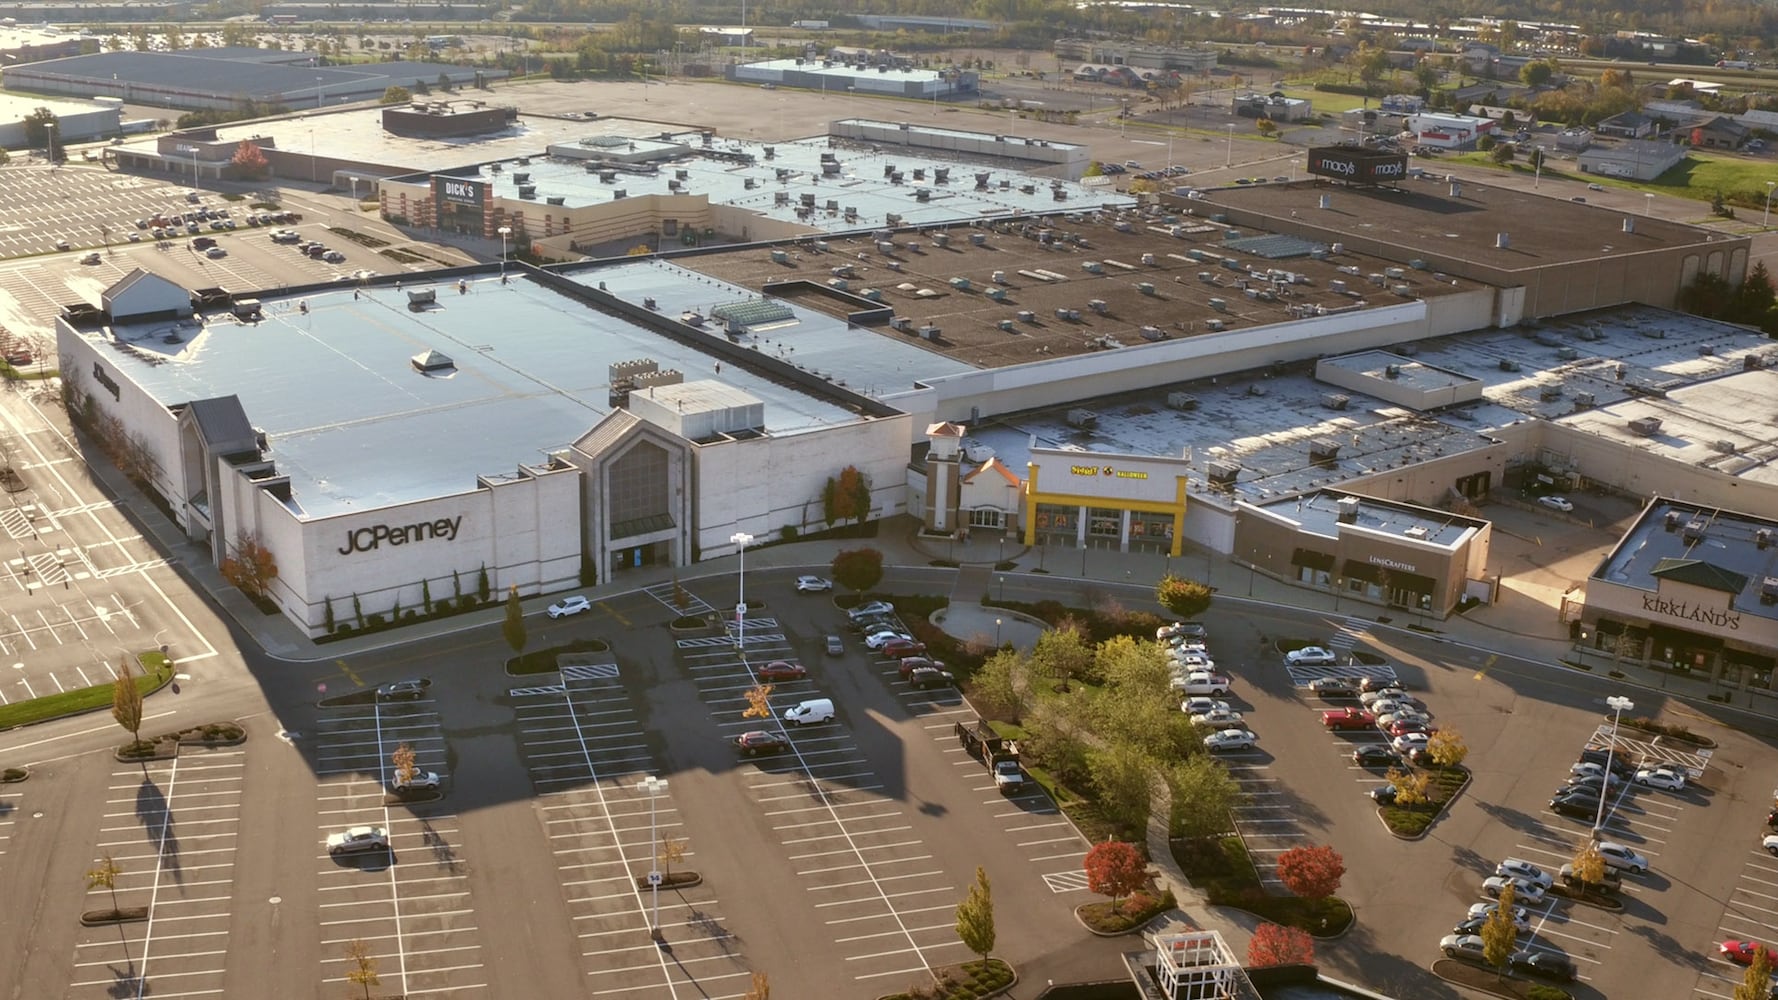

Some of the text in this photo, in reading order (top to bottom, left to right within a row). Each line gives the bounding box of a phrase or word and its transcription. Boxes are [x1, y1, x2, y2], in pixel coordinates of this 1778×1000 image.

[1322, 159, 1355, 175] macy's
[1375, 161, 1402, 175] macy's
[445, 182, 474, 197] DICK'S
[338, 515, 462, 555] JCPenney
[1643, 594, 1740, 630] KIRKLAND'S
